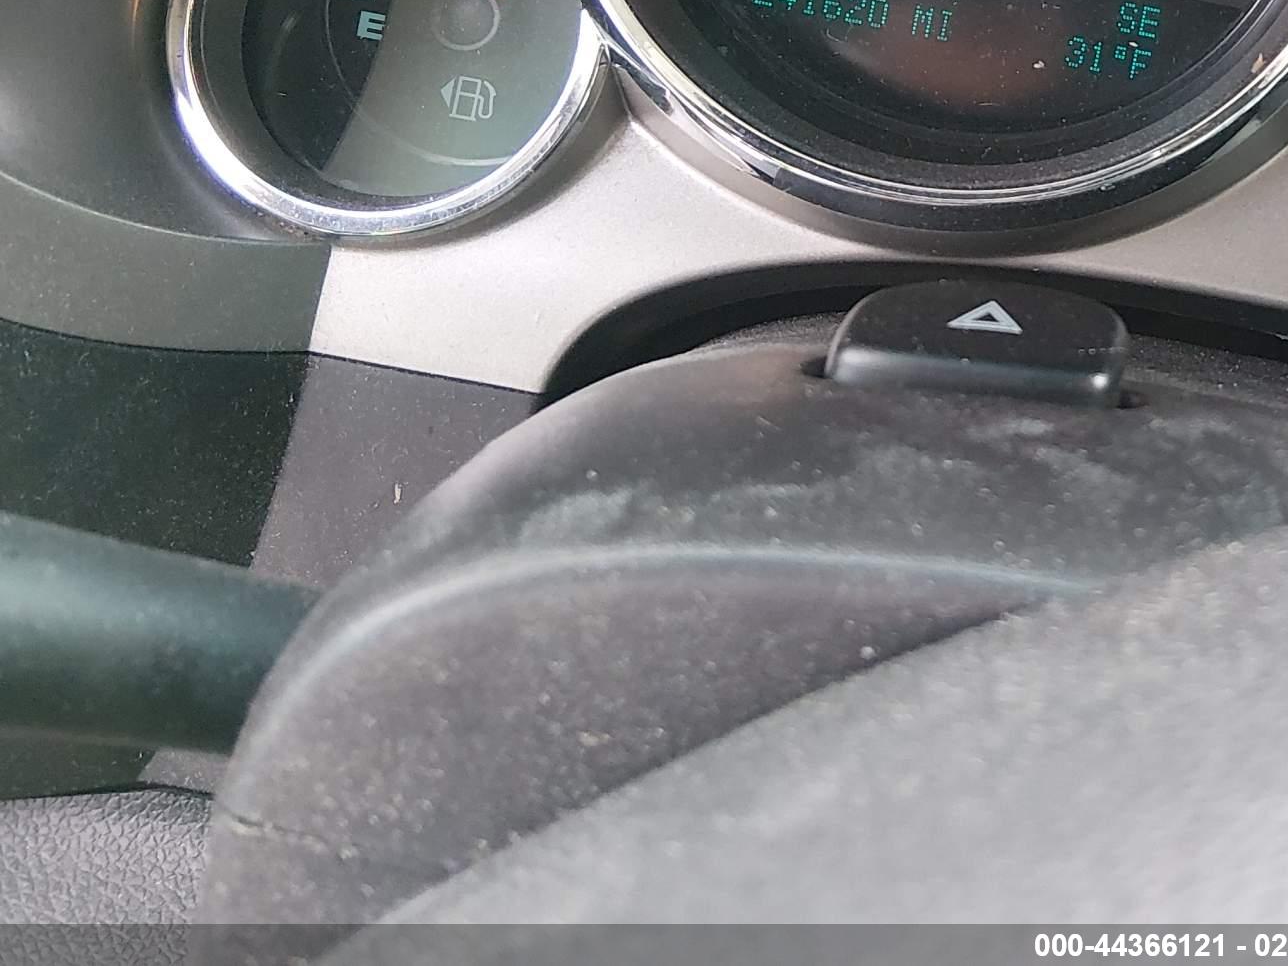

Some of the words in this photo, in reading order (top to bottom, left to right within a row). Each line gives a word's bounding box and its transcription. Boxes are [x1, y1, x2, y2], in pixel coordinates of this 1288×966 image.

[356, 10, 386, 41] E
[911, 4, 953, 42] MI
[1117, 1, 1161, 39] SE
[1064, 36, 1152, 79] 31°F
